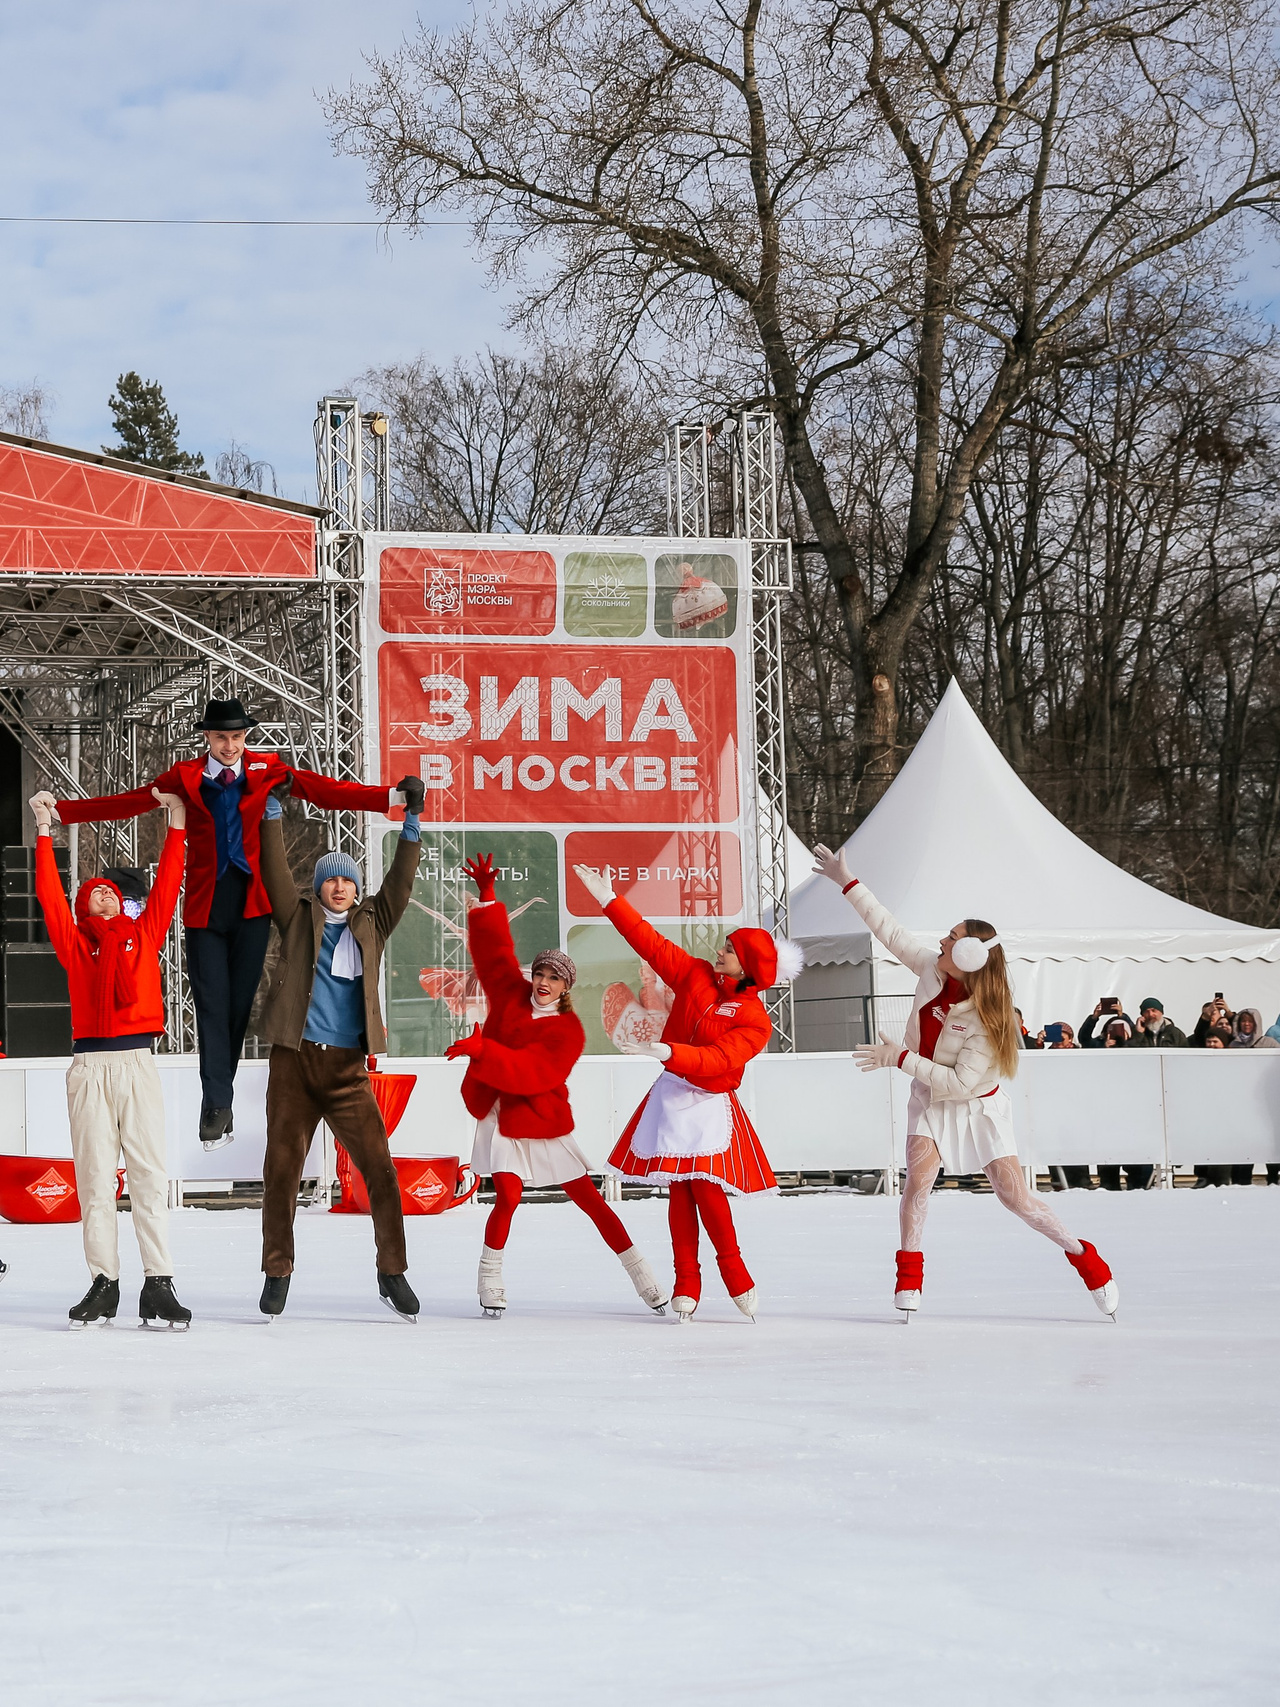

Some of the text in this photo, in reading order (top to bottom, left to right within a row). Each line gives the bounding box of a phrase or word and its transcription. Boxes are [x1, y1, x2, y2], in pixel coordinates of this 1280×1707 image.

[467, 573, 508, 583] ПРОЕКТ
[467, 584, 497, 594] МЭРА
[467, 595, 513, 605] МОСКВЫ
[581, 599, 631, 607] СОКОЛЬНИКИ
[418, 673, 698, 742] ЗИМА
[419, 753, 700, 792] В МОСКВЕ
[637, 867, 650, 881] В
[657, 866, 719, 881] ПАРК!
